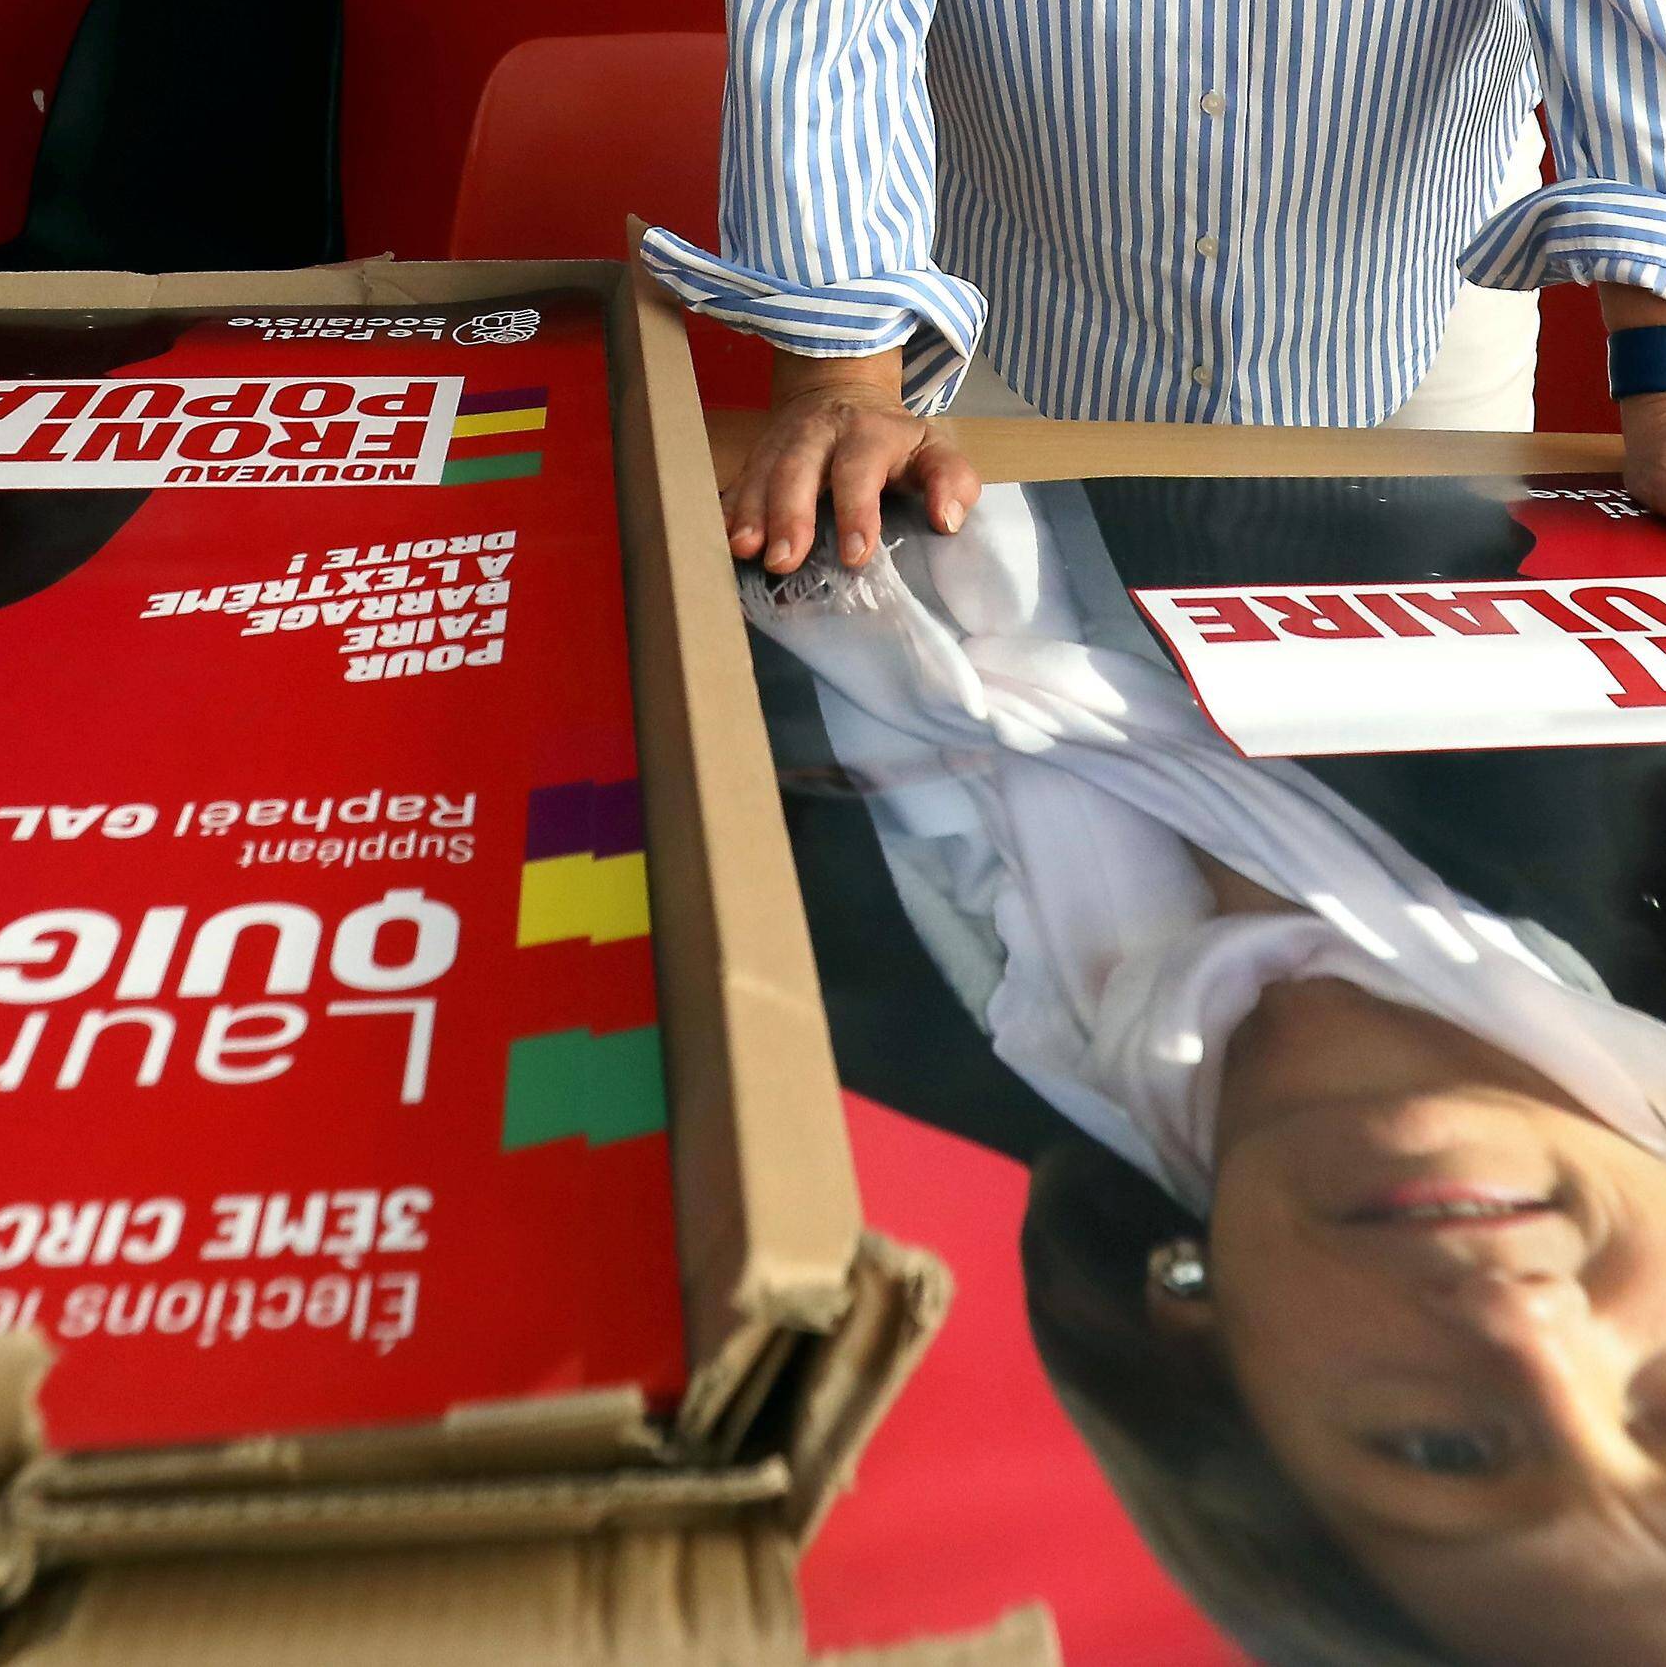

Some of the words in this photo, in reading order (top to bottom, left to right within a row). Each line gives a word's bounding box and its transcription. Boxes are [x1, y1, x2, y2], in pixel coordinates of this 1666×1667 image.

[228, 317, 447, 329] socialiste
[263, 328, 374, 341] Parti
[388, 328, 443, 340] Le
[165, 463, 416, 485] NOUVEAU
[321, 530, 517, 567] DROITE
[240, 579, 512, 637] BARRAGE
[338, 608, 509, 655] FAIRE
[343, 638, 505, 684] POUR
[173, 791, 476, 839] Raphaël
[240, 831, 474, 868] Suppléant
[200, 1186, 434, 1273] 3ÈME
[58, 1270, 422, 1355] Élections
